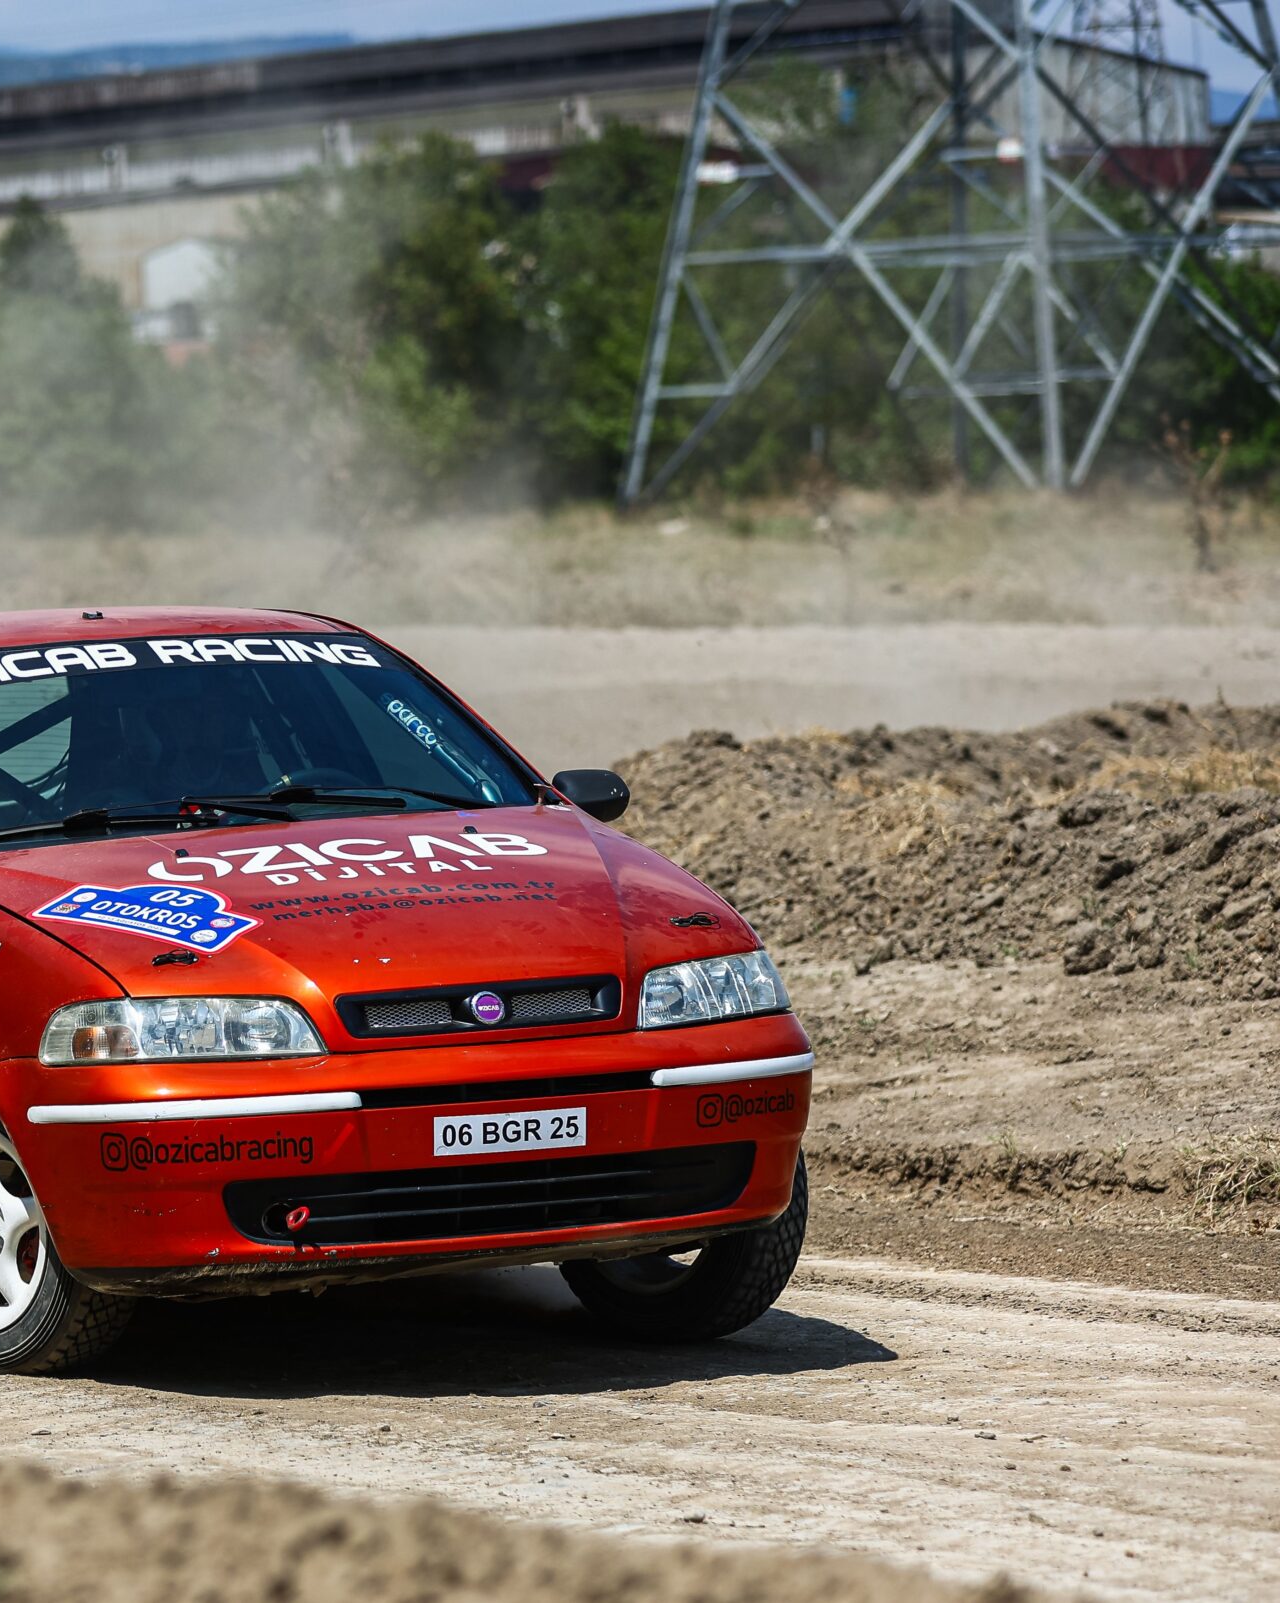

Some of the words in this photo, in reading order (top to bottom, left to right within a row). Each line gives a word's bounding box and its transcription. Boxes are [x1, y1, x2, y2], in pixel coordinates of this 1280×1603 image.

[147, 639, 382, 668] RACING
[147, 833, 549, 882] OZICAB
[149, 890, 204, 907] 05
[250, 880, 557, 911] www.ozicab.com.tr
[272, 891, 558, 921] merhaba@ozicab.net
[90, 901, 202, 929] OTOKROS
[442, 1123, 473, 1147] 06
[482, 1118, 542, 1145] BGR
[550, 1115, 580, 1140] 25
[129, 1131, 314, 1171] @ozicabracing
